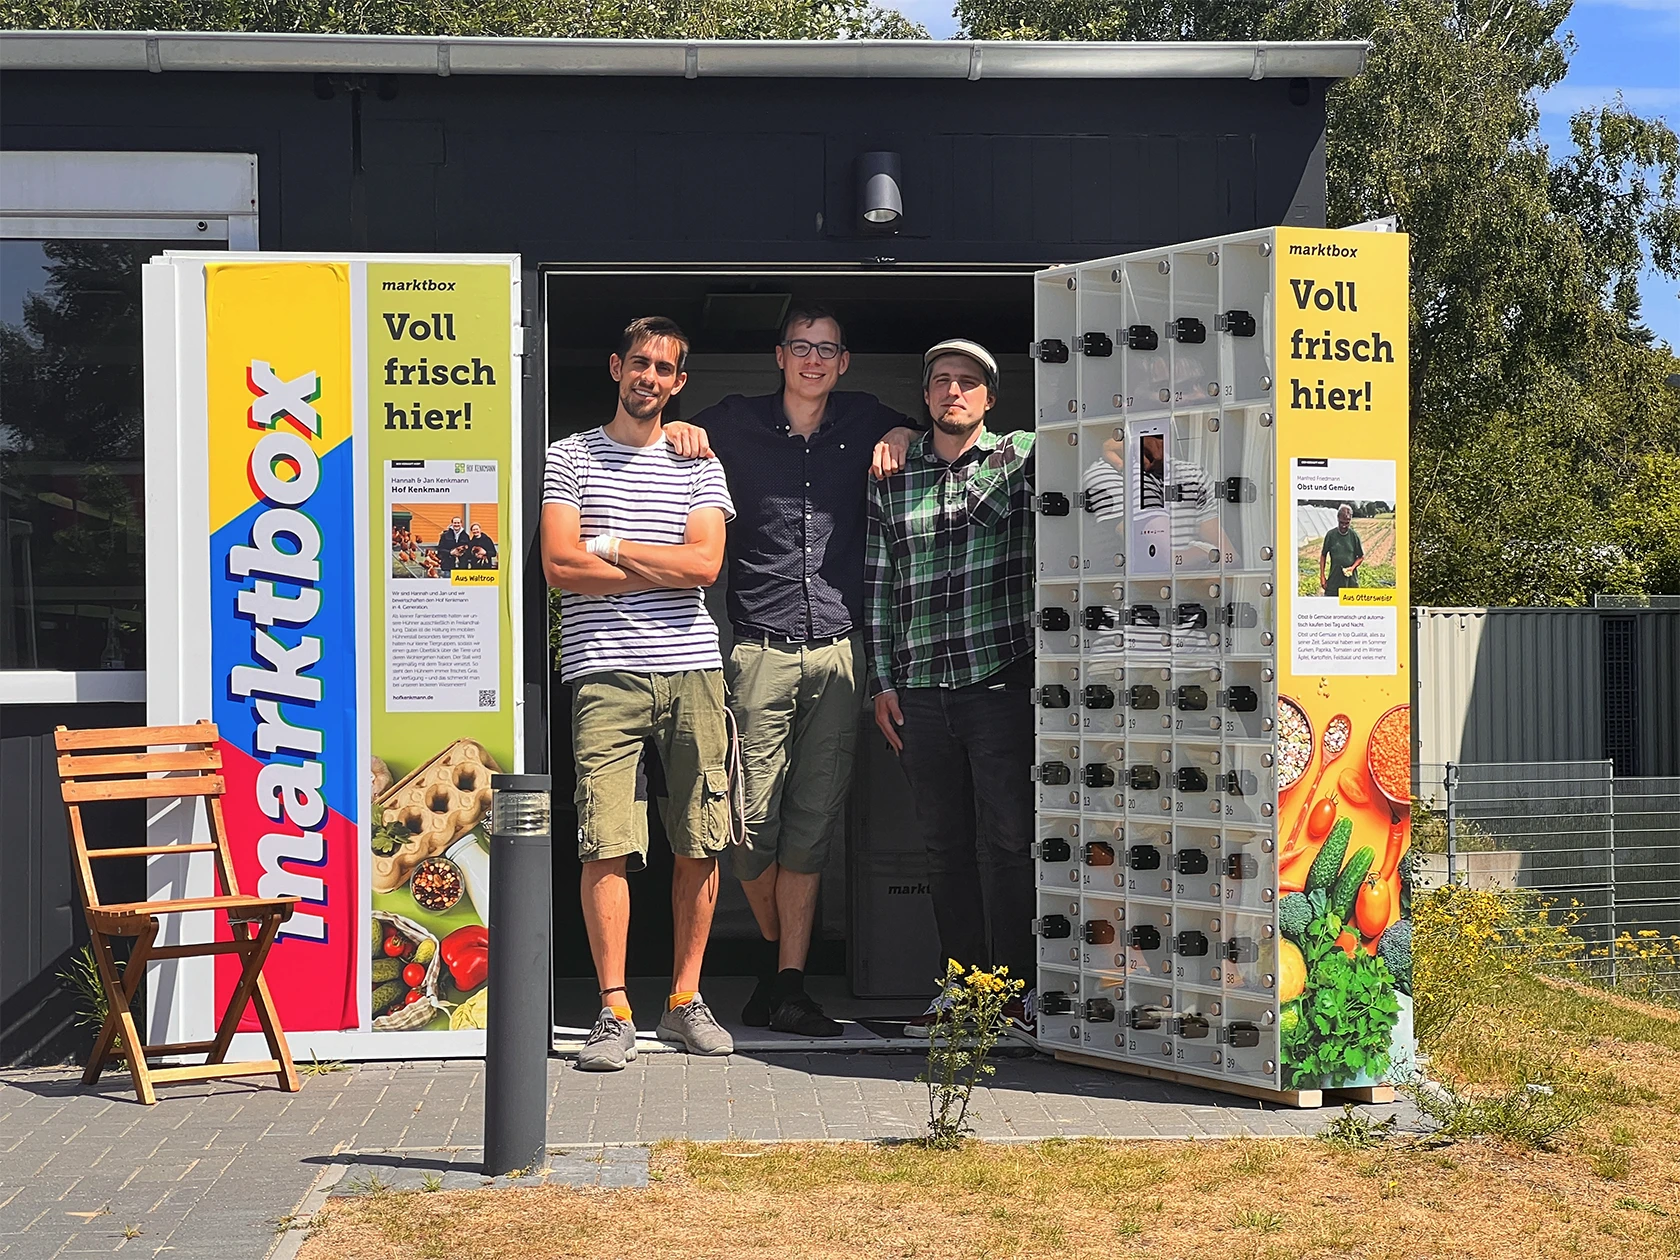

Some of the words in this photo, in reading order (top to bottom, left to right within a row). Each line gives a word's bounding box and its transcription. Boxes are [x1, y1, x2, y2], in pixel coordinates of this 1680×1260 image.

[1289, 244, 1358, 258] marktbox
[382, 279, 456, 291] marktbox
[1290, 279, 1358, 312] Voll
[382, 313, 456, 341] Voll
[1290, 328, 1394, 362] frisch
[384, 357, 496, 386] frisch
[1225, 386, 1232, 396] 32
[1290, 378, 1372, 412] hier!
[1175, 392, 1182, 401] 24
[1126, 397, 1133, 407] 17
[1039, 408, 1043, 418] 1
[1082, 403, 1086, 413] 9
[384, 402, 472, 430] hier!
[1225, 554, 1233, 563] 33
[1040, 563, 1044, 572] 2
[1083, 560, 1090, 569] 10
[1083, 640, 1090, 648] 11
[1225, 638, 1233, 648] 34
[229, 359, 326, 942] marktbox
[1040, 717, 1043, 726] 4
[1083, 718, 1090, 728] 12
[1128, 719, 1136, 729] 19
[1176, 720, 1183, 730] 27
[1226, 722, 1234, 732] 35
[1040, 794, 1043, 803] 5
[1083, 796, 1090, 806] 13
[1128, 800, 1135, 809] 20
[1176, 802, 1183, 811] 28
[1225, 806, 1233, 815] 36
[1040, 872, 1043, 881] 6
[1083, 875, 1090, 884] 14
[888, 884, 931, 894] markt
[1128, 880, 1136, 889] 21
[1177, 884, 1184, 894] 29
[1226, 889, 1233, 899] 37
[1040, 948, 1044, 957] 7
[1083, 954, 1090, 963] 15
[1130, 960, 1137, 969] 22
[1177, 967, 1184, 977] 30
[1226, 974, 1234, 984] 38
[1041, 1025, 1045, 1034] 8
[1084, 1032, 1091, 1042] 16
[1129, 1040, 1136, 1050] 23
[1176, 1049, 1184, 1059] 31
[1227, 1058, 1234, 1068] 39
